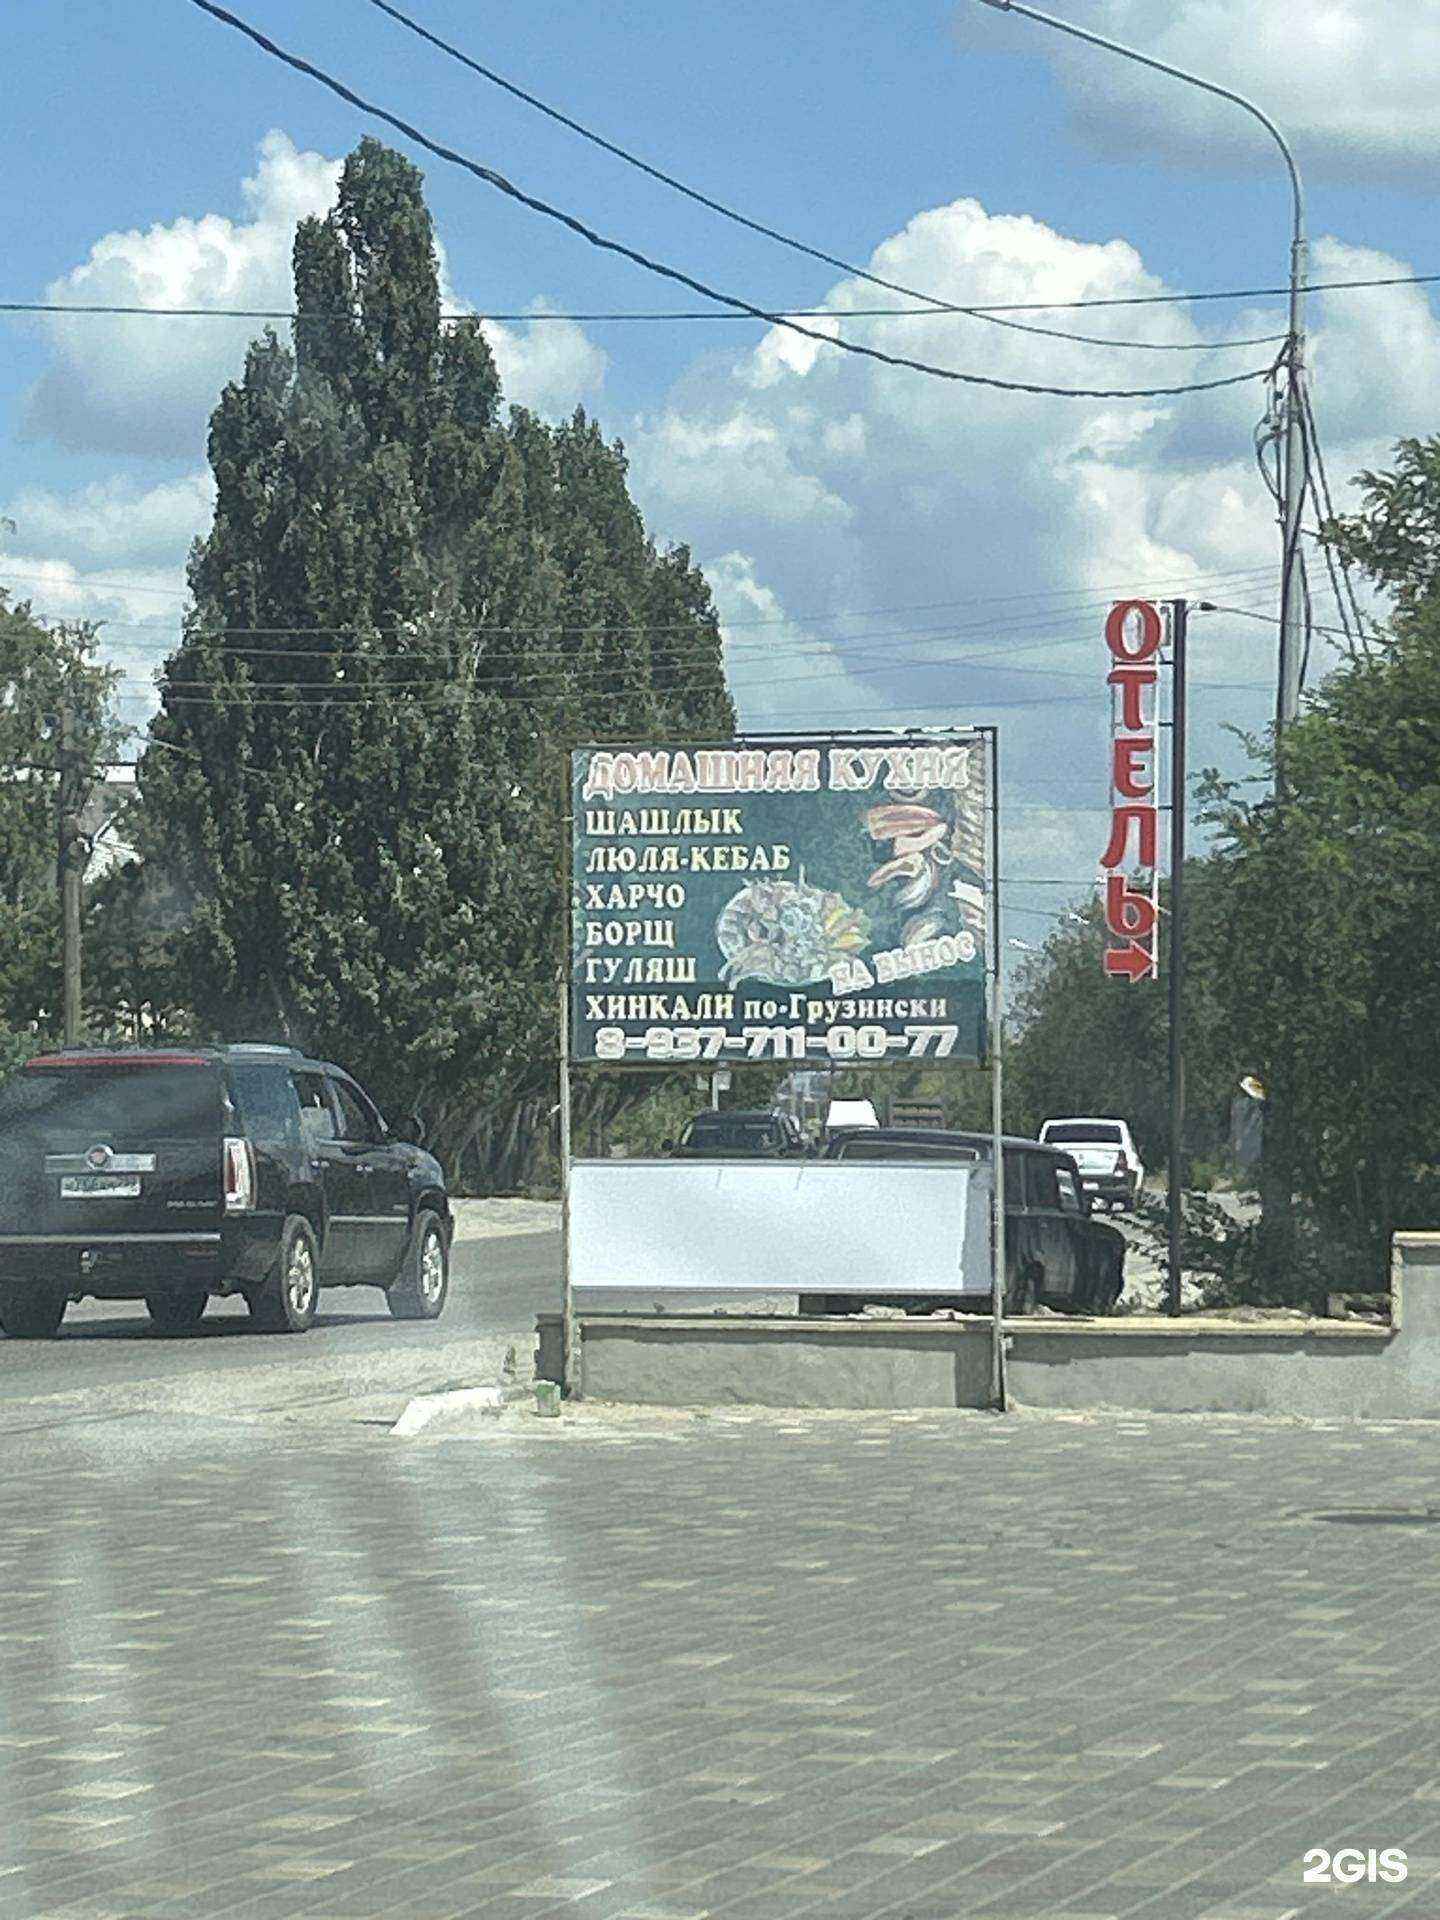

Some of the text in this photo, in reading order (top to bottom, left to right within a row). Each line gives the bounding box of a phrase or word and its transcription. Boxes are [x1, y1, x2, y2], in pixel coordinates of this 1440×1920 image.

[583, 747, 969, 800] ДОМАШНЯЯ КУХНЯ
[1100, 599, 1161, 937] ОТЕЛЬ
[585, 808, 744, 835] ШАШЛЫК
[585, 845, 790, 873] ЛЮЛЯ-КЕБАБ
[585, 883, 685, 909] ХАРЧО
[585, 919, 675, 948] БОРЩ
[585, 957, 696, 983] ГУЛЯШ
[585, 993, 947, 1024] ХИНКАЛИ по-Грузински
